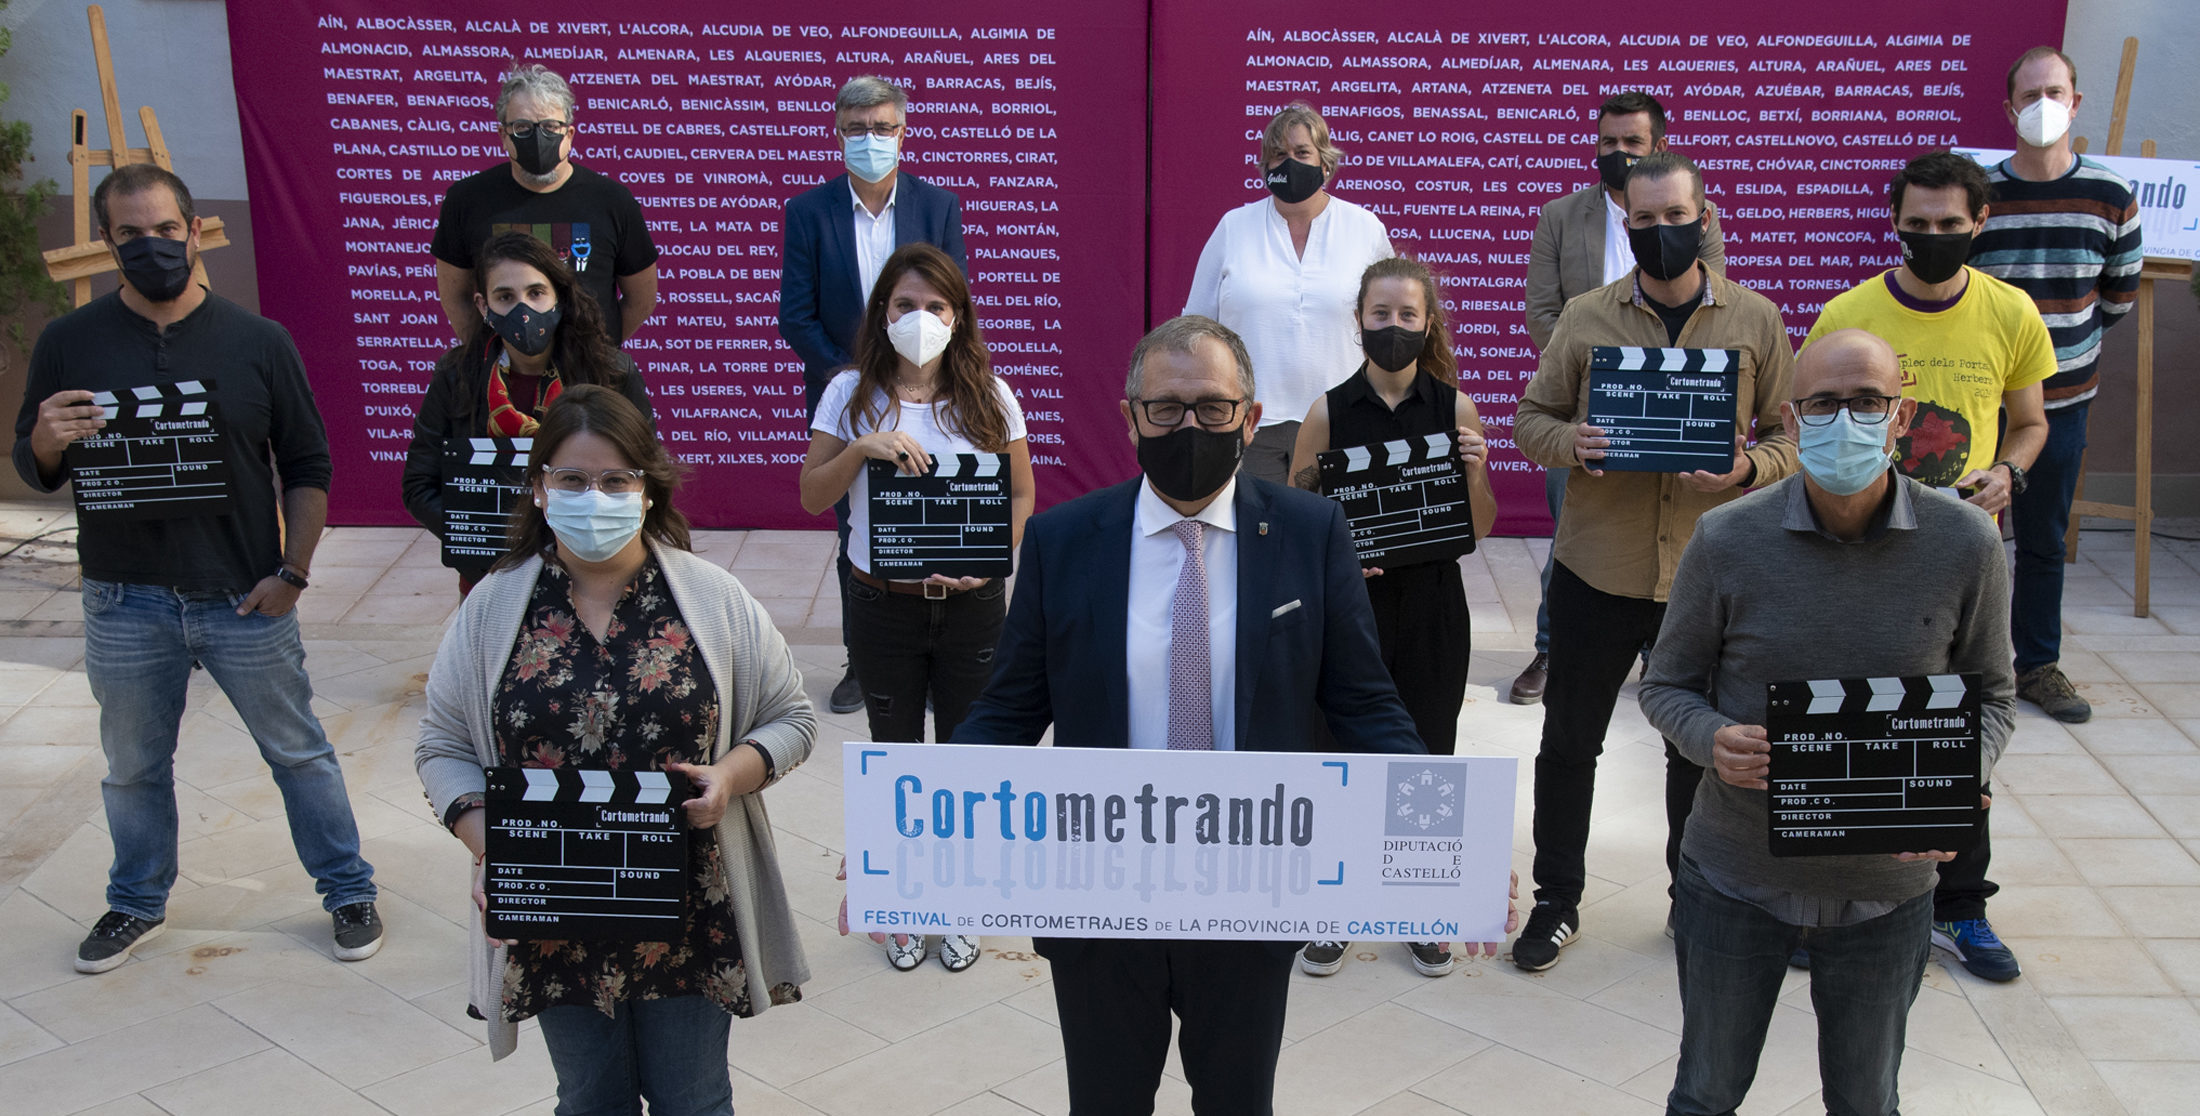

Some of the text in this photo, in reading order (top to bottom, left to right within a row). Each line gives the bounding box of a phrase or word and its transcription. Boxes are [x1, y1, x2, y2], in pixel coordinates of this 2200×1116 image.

[318, 15, 1055, 40] AÍN, ALBOCÀSSER, ALCALÀ DE XIVERT, L'ALCORA, ALCUDIA DE VEO, ALFONDEGUILLA, ALGIMIA DE
[1247, 28, 1971, 48] AÍN, ALBOCÀSSER, ALCALÀ DE XIVERT, L'ALCORA, ALCUDIA DE VEO, ALFONDEGUILLA, ALGIMIA DE
[322, 43, 1056, 65] ALMONACID, ALMASSORA, ALMEDÍJAR, ALMENARA, LES ALQUERIES, ALTURA, ARAÑUEL, ARES DEL
[324, 68, 1056, 91] MAESTRAT, ARGELITA, ATZENETA DEL MAESTRAT, AYÓDAR, BARRACAS, BEJÍS,
[1246, 81, 1964, 98] MAESTRAT, ARGELITA, ARTANA, ATZENETA DEL AYÓDAR, AZUÉBAR, BARRACAS, BEJÍS,
[1322, 106, 1960, 122] BENAFIGOS, BENASSAL, BENICARLÓ, BENLLOC, BETXÍ, BORRIANA, BORRIOL,
[620, 171, 1058, 189] COVES DE VINROMÀ, FANZARA,
[1336, 180, 1562, 192] ARENOSO, COSTUR, LES COVES
[997, 223, 1059, 237] MONTÁN,
[1751, 232, 1875, 244] MATET, MONCOFA,
[976, 249, 1059, 260] PALANQUES,
[1418, 253, 1481, 265] NAVAJAS,
[354, 313, 437, 324] SANT JOAN
[1456, 324, 1499, 336] JORDI,
[359, 360, 401, 372] TOGA,
[649, 363, 693, 374] PINAR,
[700, 363, 768, 372] LA TORRE
[1899, 358, 1925, 369] plec
[1930, 357, 1954, 366] dels
[692, 386, 786, 396] USERES, VALL
[365, 405, 415, 418] D'UIXÓ,
[672, 409, 761, 419] VILAFRANCA,
[705, 429, 731, 442] RÍO,
[1341, 478, 1457, 501] SCENE TAKE ROLL
[1423, 507, 1451, 515] SOUND
[1892, 716, 1965, 730] Cortometrando
[1792, 744, 1832, 752] SCENE
[1866, 742, 1899, 750] TAKE
[601, 810, 669, 823] Cortometrando
[895, 775, 1314, 847] Cortometrando
[509, 830, 547, 838] SCENE
[1384, 839, 1462, 852] DIPUTACIÓ
[620, 871, 660, 879] SOUND
[1382, 866, 1461, 879] CASTELLÓ
[864, 910, 1458, 936] FESTIVAL DE CORTOMETRAJES DE LA PROVINCIA DE CASTELLÓN
